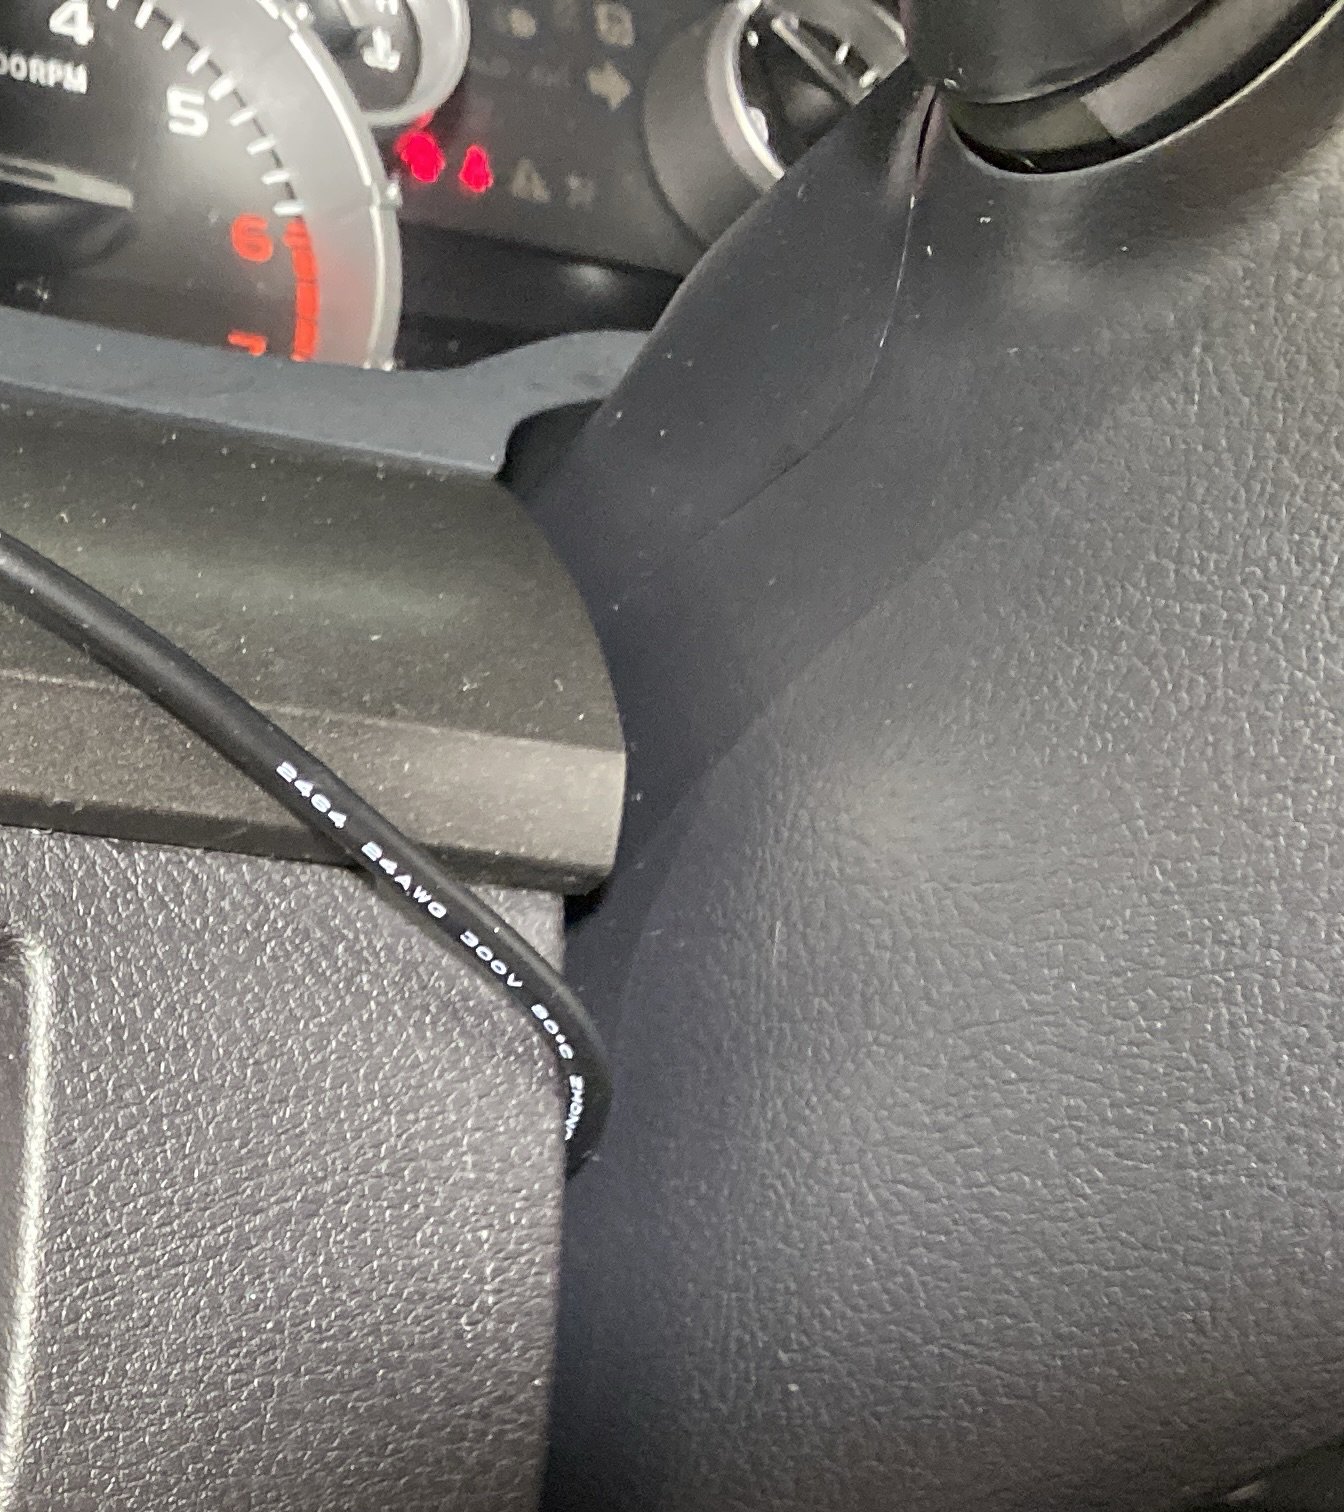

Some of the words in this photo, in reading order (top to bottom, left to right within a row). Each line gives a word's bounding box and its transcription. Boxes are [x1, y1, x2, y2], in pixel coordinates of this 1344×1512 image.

[49, 0, 94, 46] 4
[167, 85, 209, 137] 5
[231, 214, 273, 263] 6
[276, 761, 347, 829] 2464
[459, 930, 523, 988] 300V
